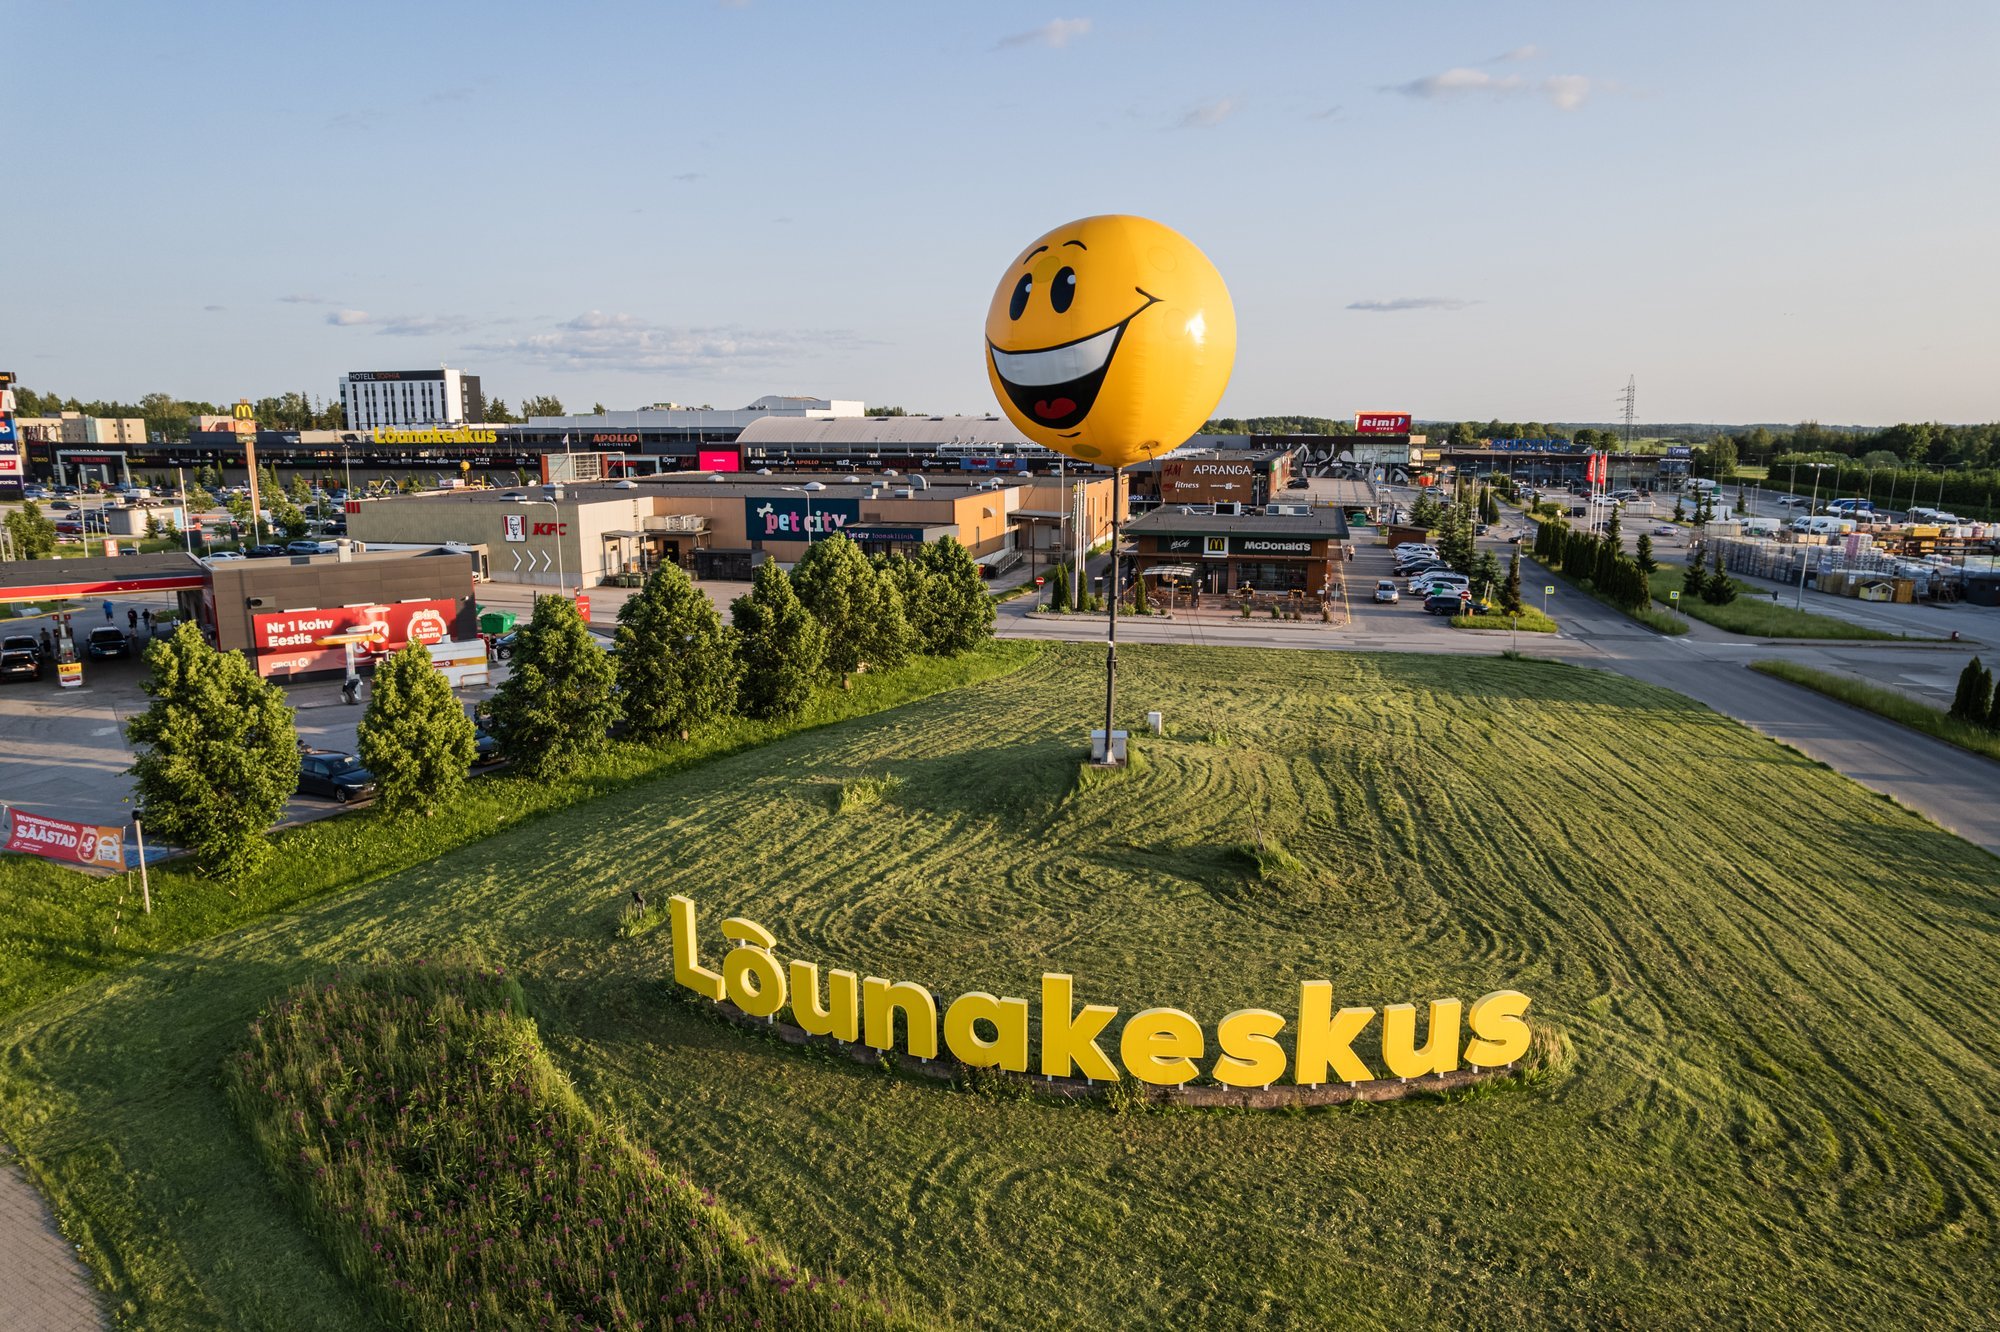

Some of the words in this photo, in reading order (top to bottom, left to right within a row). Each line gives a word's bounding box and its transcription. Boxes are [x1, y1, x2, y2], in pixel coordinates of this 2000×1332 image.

[1362, 418, 1395, 427] Rimi
[374, 426, 497, 444] Lõunakeskus
[593, 434, 638, 443] APOLLO
[0, 443, 14, 452] SK
[1193, 464, 1251, 475] APRANGA
[1175, 481, 1199, 489] fitness
[765, 511, 800, 535] pet
[804, 511, 847, 534] city
[533, 523, 567, 536] KFC
[1244, 541, 1311, 551] McDonald's
[267, 622, 285, 634] Nr
[288, 621, 295, 632] 1
[298, 619, 334, 630] kohv
[268, 634, 312, 647] Eestis
[271, 660, 297, 668] CIRCLE
[16, 824, 77, 847] SÄÄSTAD
[670, 894, 1531, 1087] Lõunakeskus
